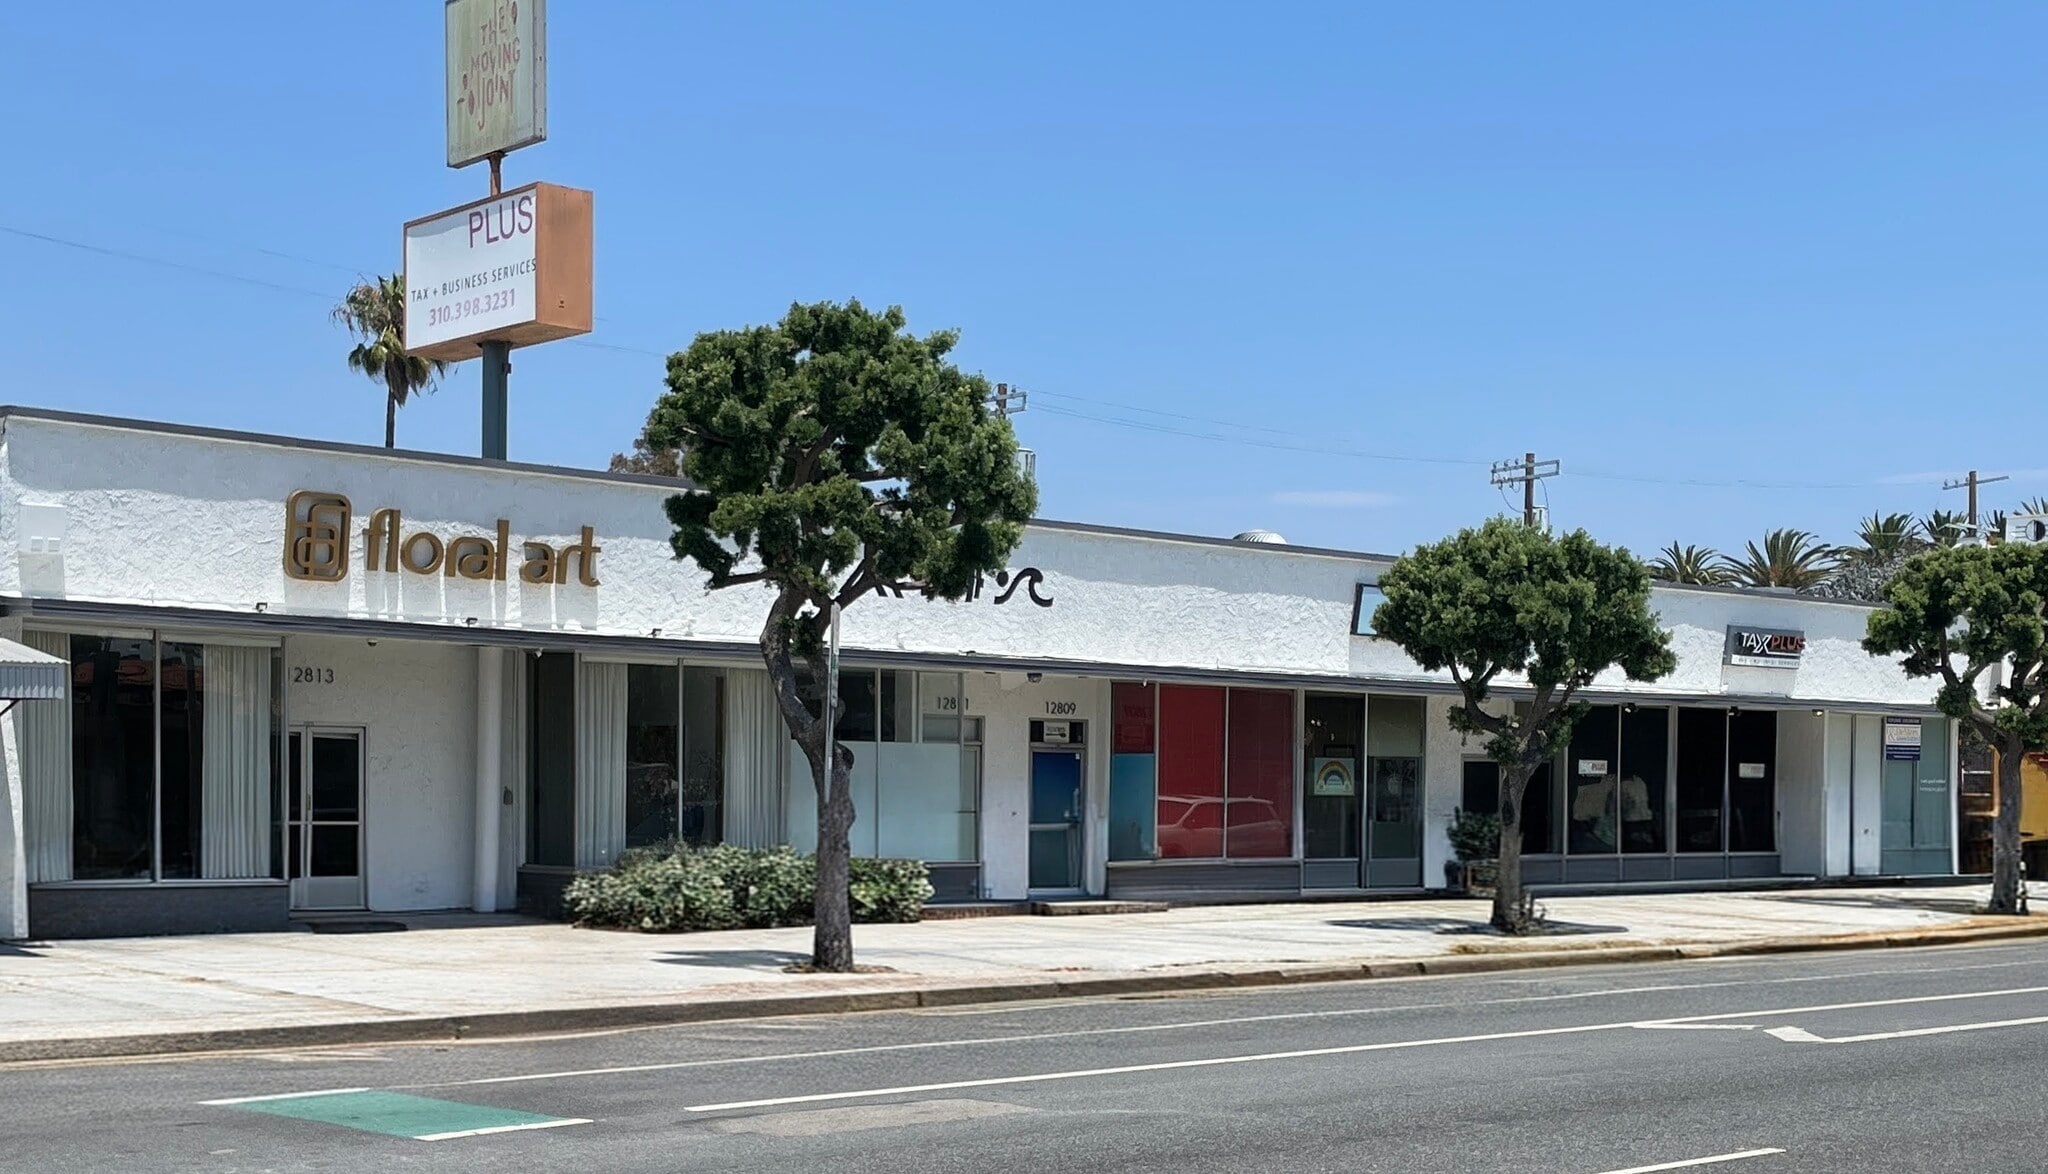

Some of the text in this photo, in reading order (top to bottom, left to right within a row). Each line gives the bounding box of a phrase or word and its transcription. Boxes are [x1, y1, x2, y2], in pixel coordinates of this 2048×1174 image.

[471, 37, 520, 78] MOVING
[478, 69, 515, 131] JOINT
[469, 195, 533, 248] PLUS
[411, 288, 428, 302] TAX
[442, 271, 488, 296] BUSINESS
[492, 258, 536, 282] SERVICES
[429, 288, 515, 326] 310.398.3231
[362, 507, 601, 587] floral art
[937, 696, 969, 710] 1281
[1045, 701, 1077, 715] 12809
